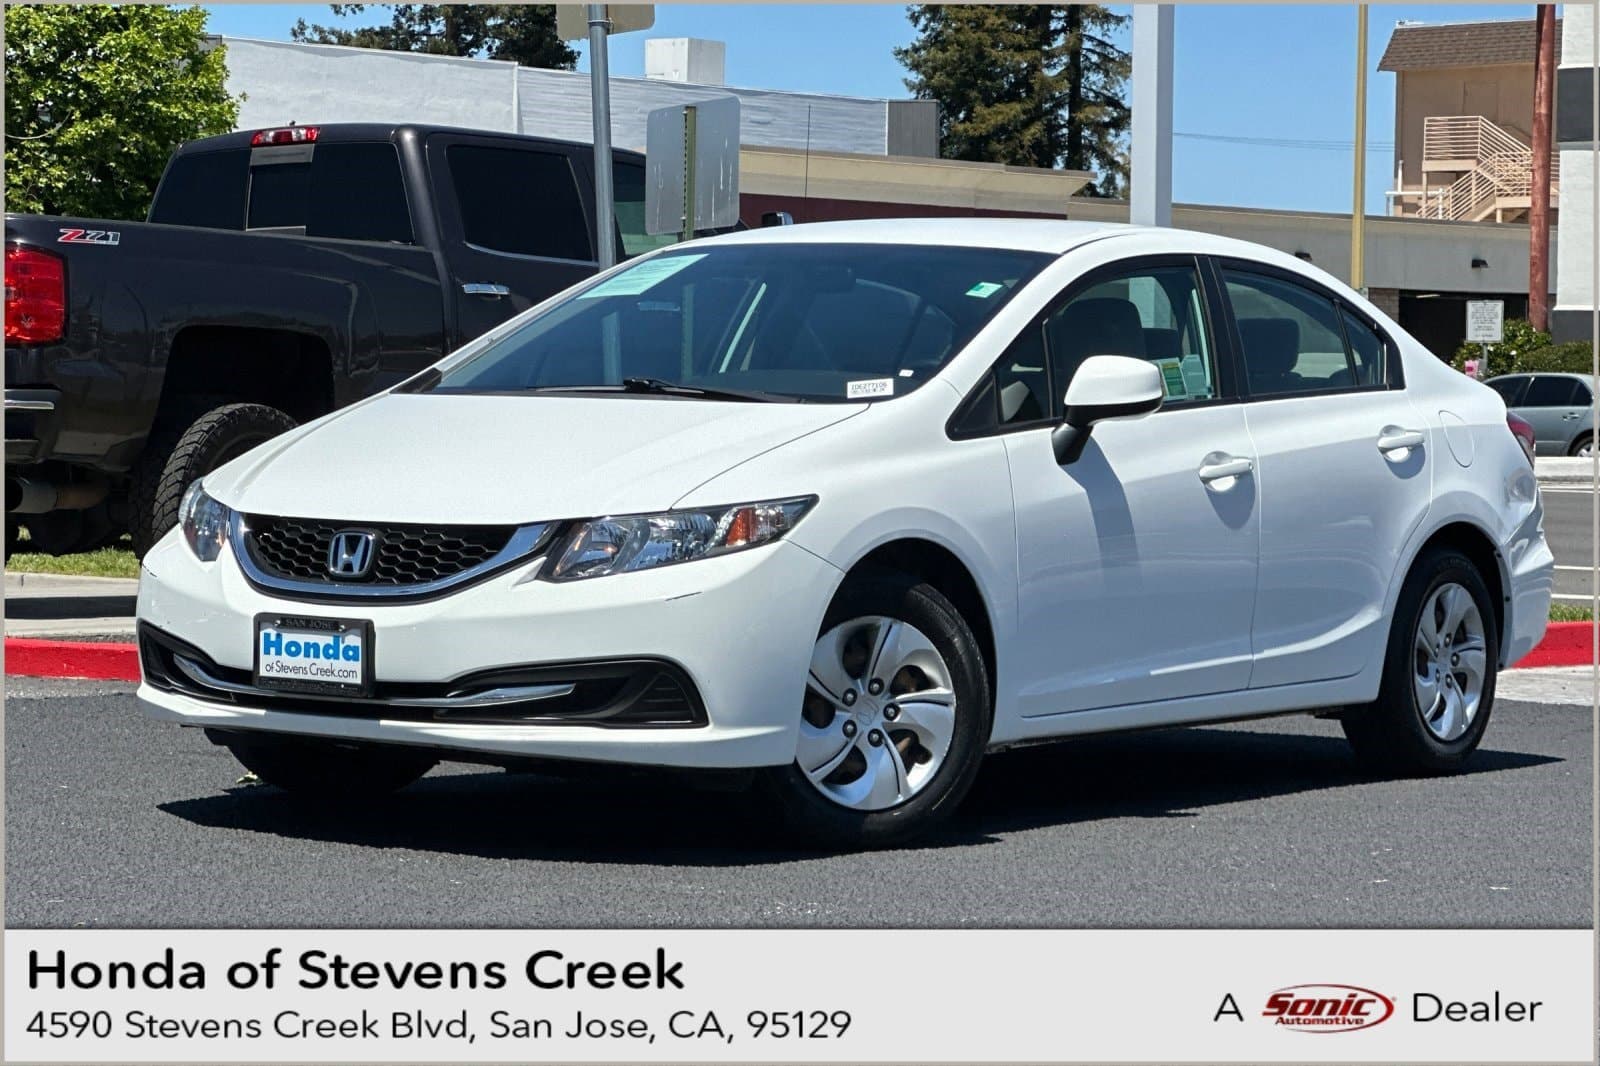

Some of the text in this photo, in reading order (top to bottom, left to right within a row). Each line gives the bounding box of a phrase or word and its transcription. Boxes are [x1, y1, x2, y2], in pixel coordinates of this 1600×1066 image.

[57, 228, 121, 246] Z71
[286, 618, 334, 630] SAN JOSE
[263, 632, 360, 662] Honda
[265, 660, 358, 679] of Stevens Creek.com
